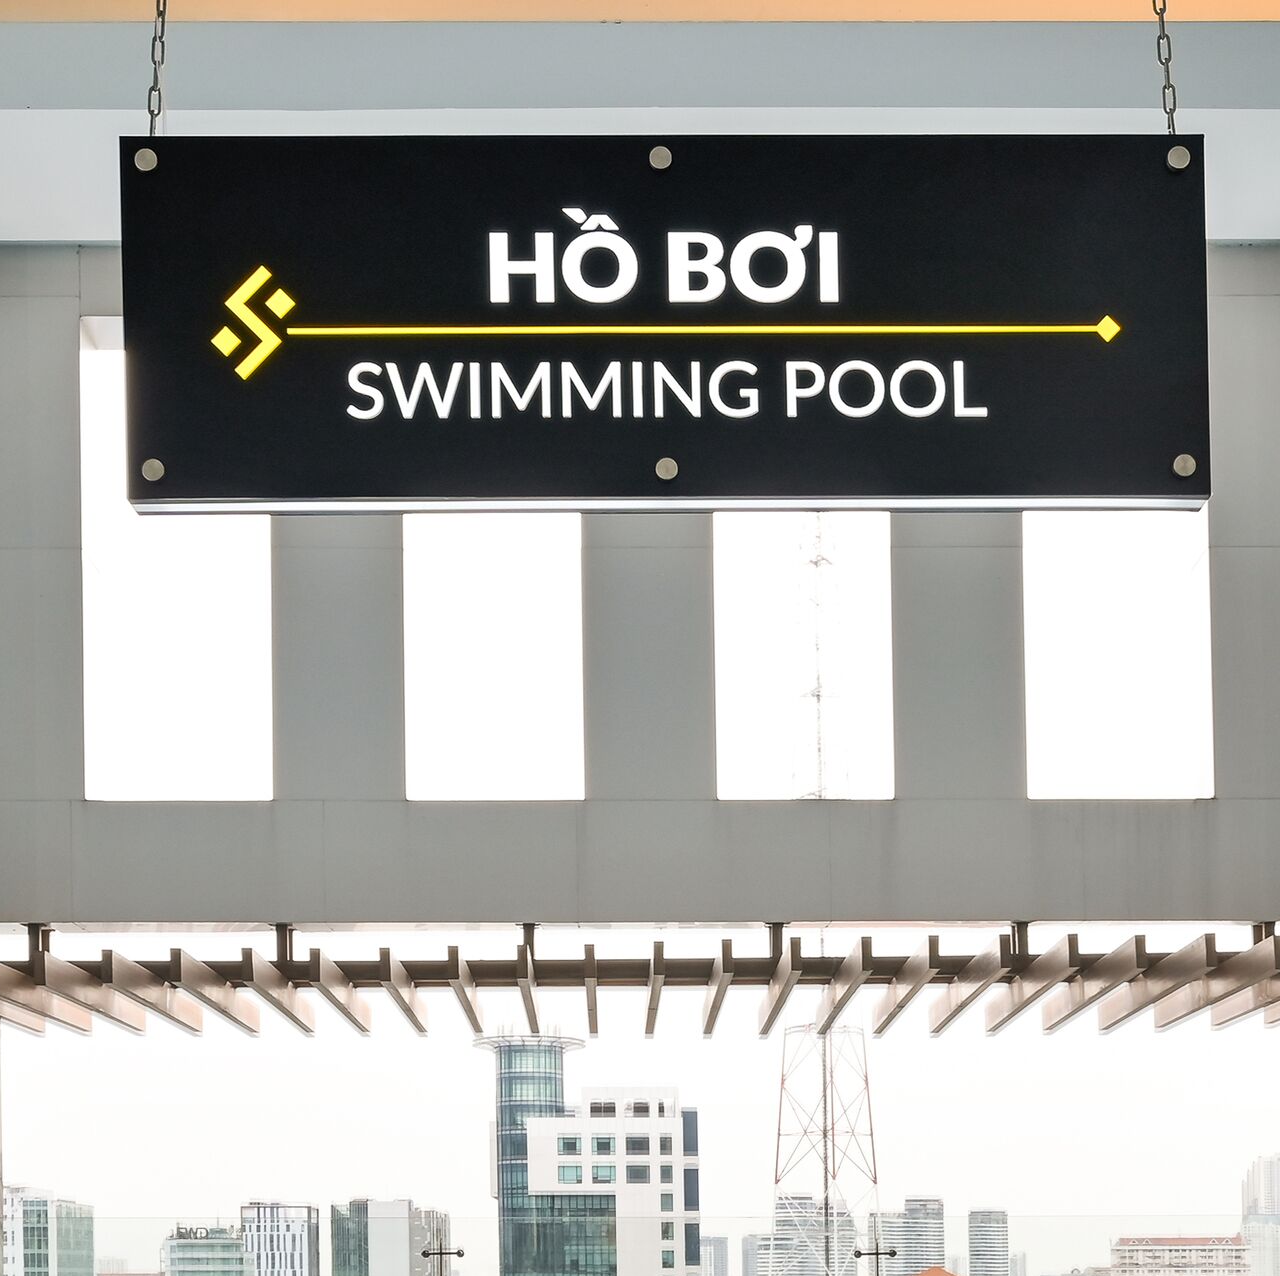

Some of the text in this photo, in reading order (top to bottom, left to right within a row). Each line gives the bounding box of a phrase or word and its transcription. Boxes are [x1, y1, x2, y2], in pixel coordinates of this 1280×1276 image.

[488, 207, 840, 304] HỒ BƠI
[346, 359, 988, 420] SWIMMING POOL
